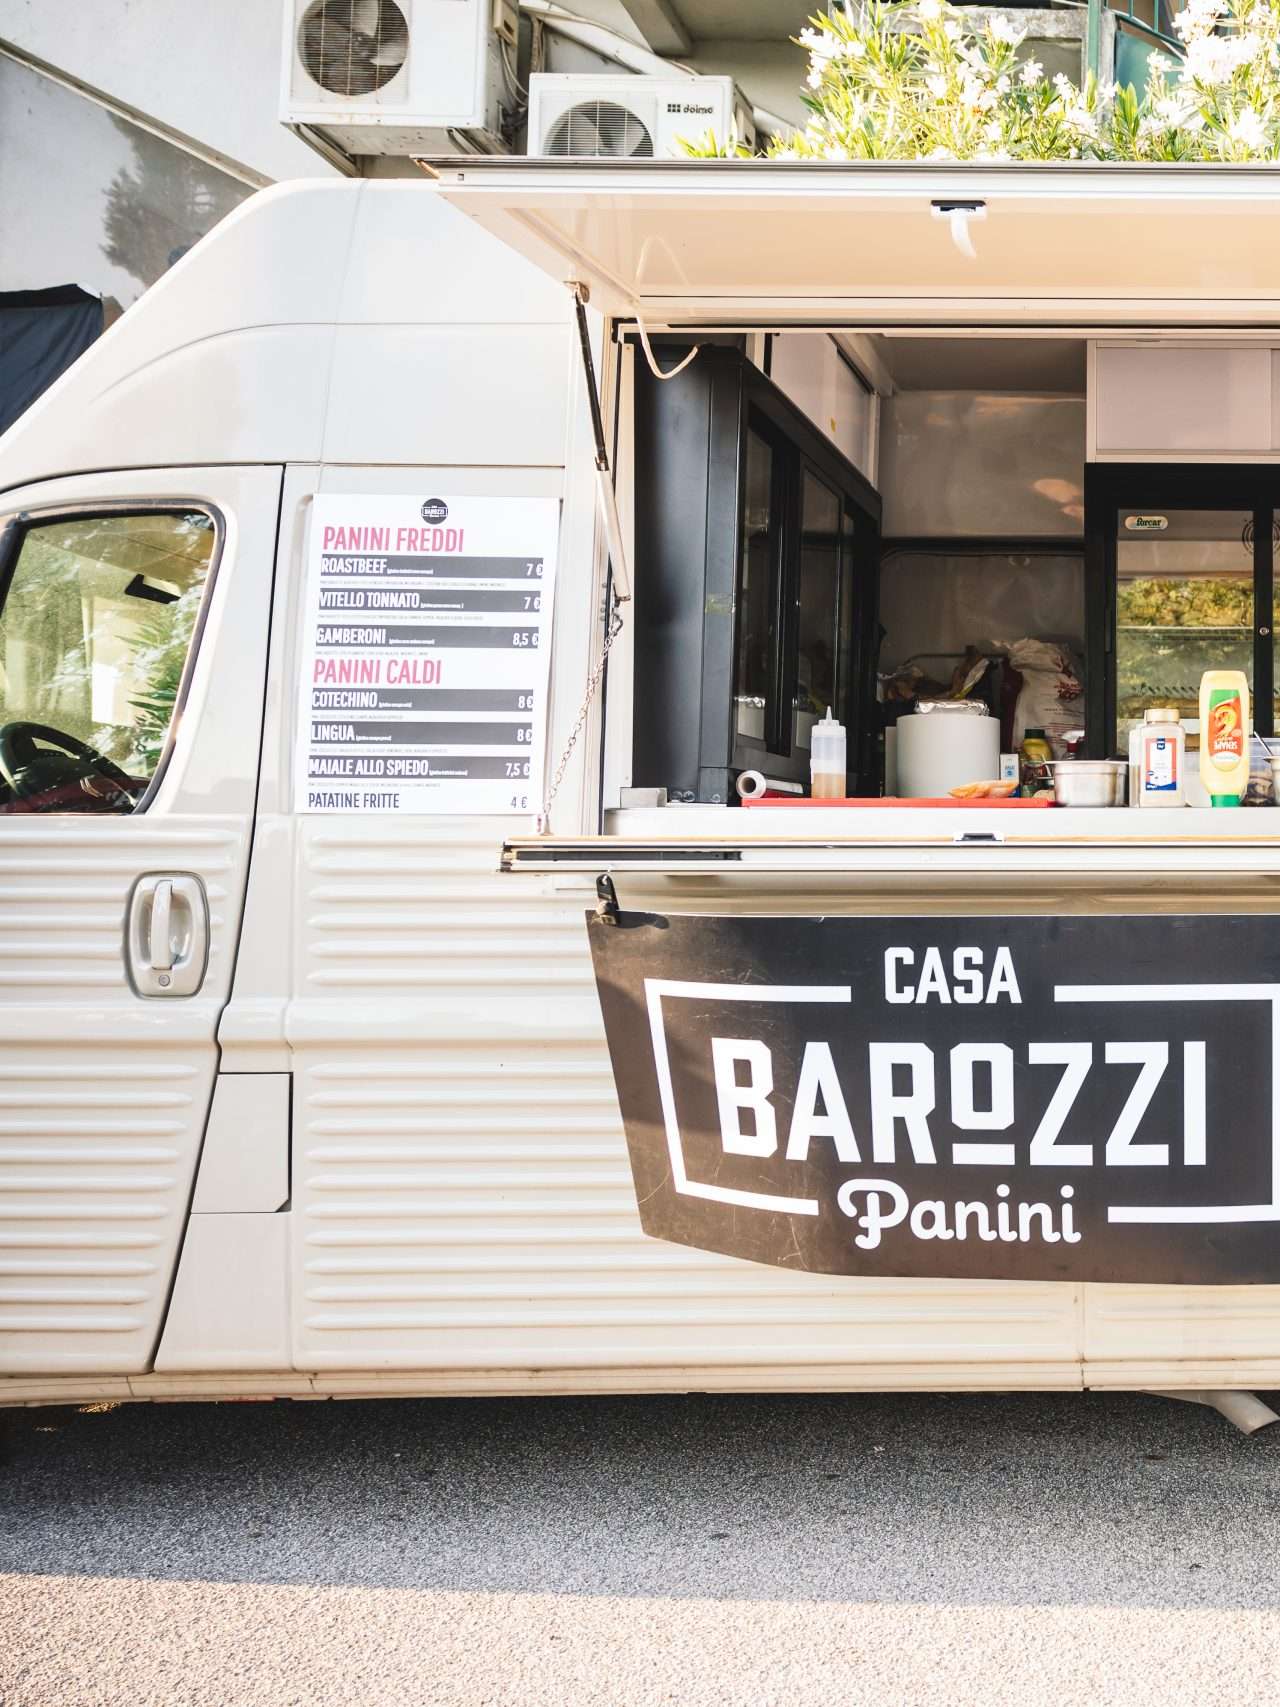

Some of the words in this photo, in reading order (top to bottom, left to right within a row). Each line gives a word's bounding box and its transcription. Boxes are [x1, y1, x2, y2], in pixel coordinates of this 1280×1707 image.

[322, 527, 390, 550] PANINI
[396, 528, 464, 552] FREDDI
[320, 558, 388, 574] ROASTBEEF
[526, 563, 534, 576] 7
[320, 591, 365, 607] VITELLO
[366, 592, 420, 608] TONNATO
[524, 596, 531, 610] 7
[317, 627, 386, 644] GAMBERONI
[313, 658, 380, 684] PANINI
[386, 659, 441, 684] CALDI
[312, 691, 378, 708] COTECHINO
[311, 724, 356, 741] LINGUA
[308, 758, 354, 775] MAIALE
[354, 760, 384, 776] ALLO
[386, 760, 429, 776] SPIEDO
[308, 792, 360, 808] PATATINE
[364, 793, 400, 808] FRITTE
[510, 796, 517, 808] 4
[521, 796, 528, 808] €
[884, 946, 1022, 1004] CASA
[711, 1038, 1207, 1166] BAROZZI
[836, 1178, 1082, 1250] Panini
